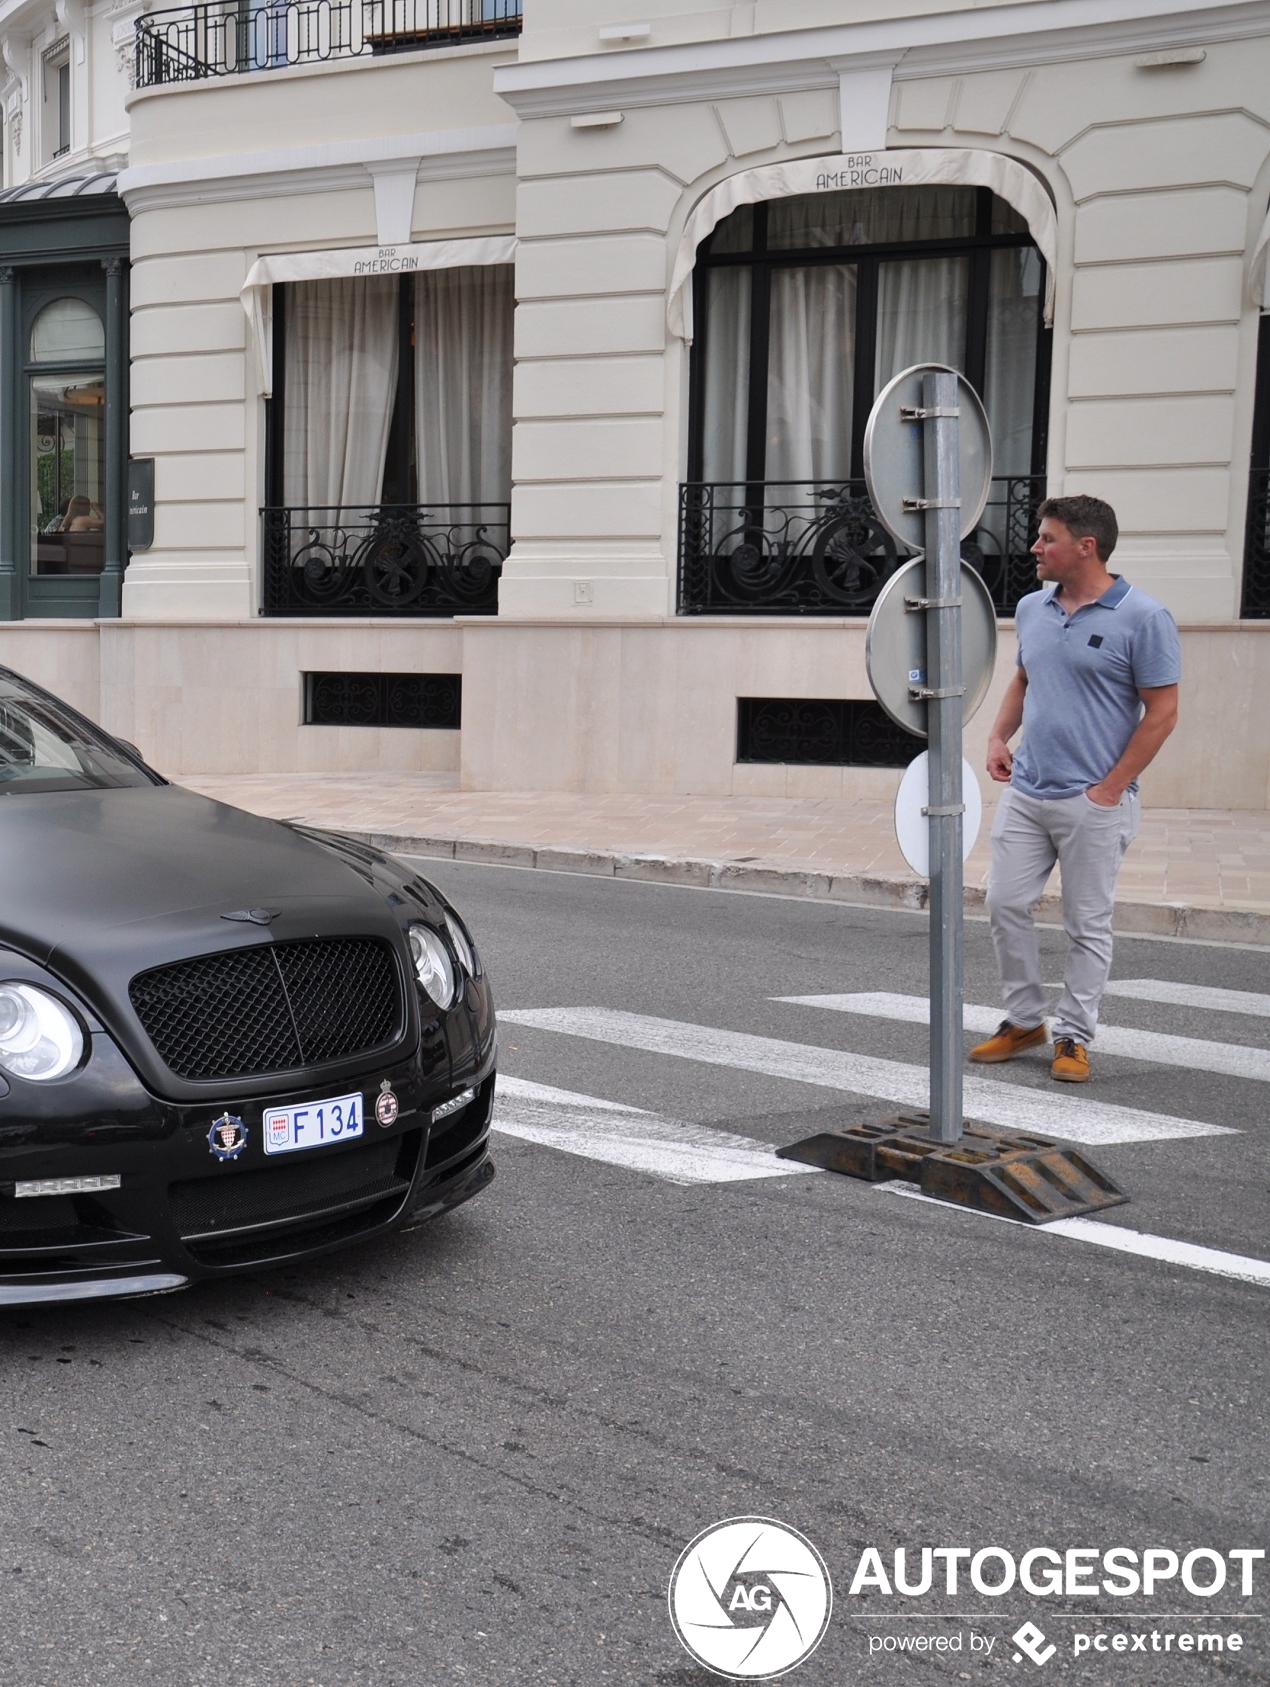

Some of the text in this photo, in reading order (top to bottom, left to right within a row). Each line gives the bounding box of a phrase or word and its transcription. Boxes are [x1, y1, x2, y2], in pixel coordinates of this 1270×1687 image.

[848, 155, 872, 169] BAR
[816, 167, 903, 190] AMERICAIN
[378, 248, 396, 259] BAR
[354, 256, 419, 274] AMERICAIN
[273, 1130, 286, 1141] MC
